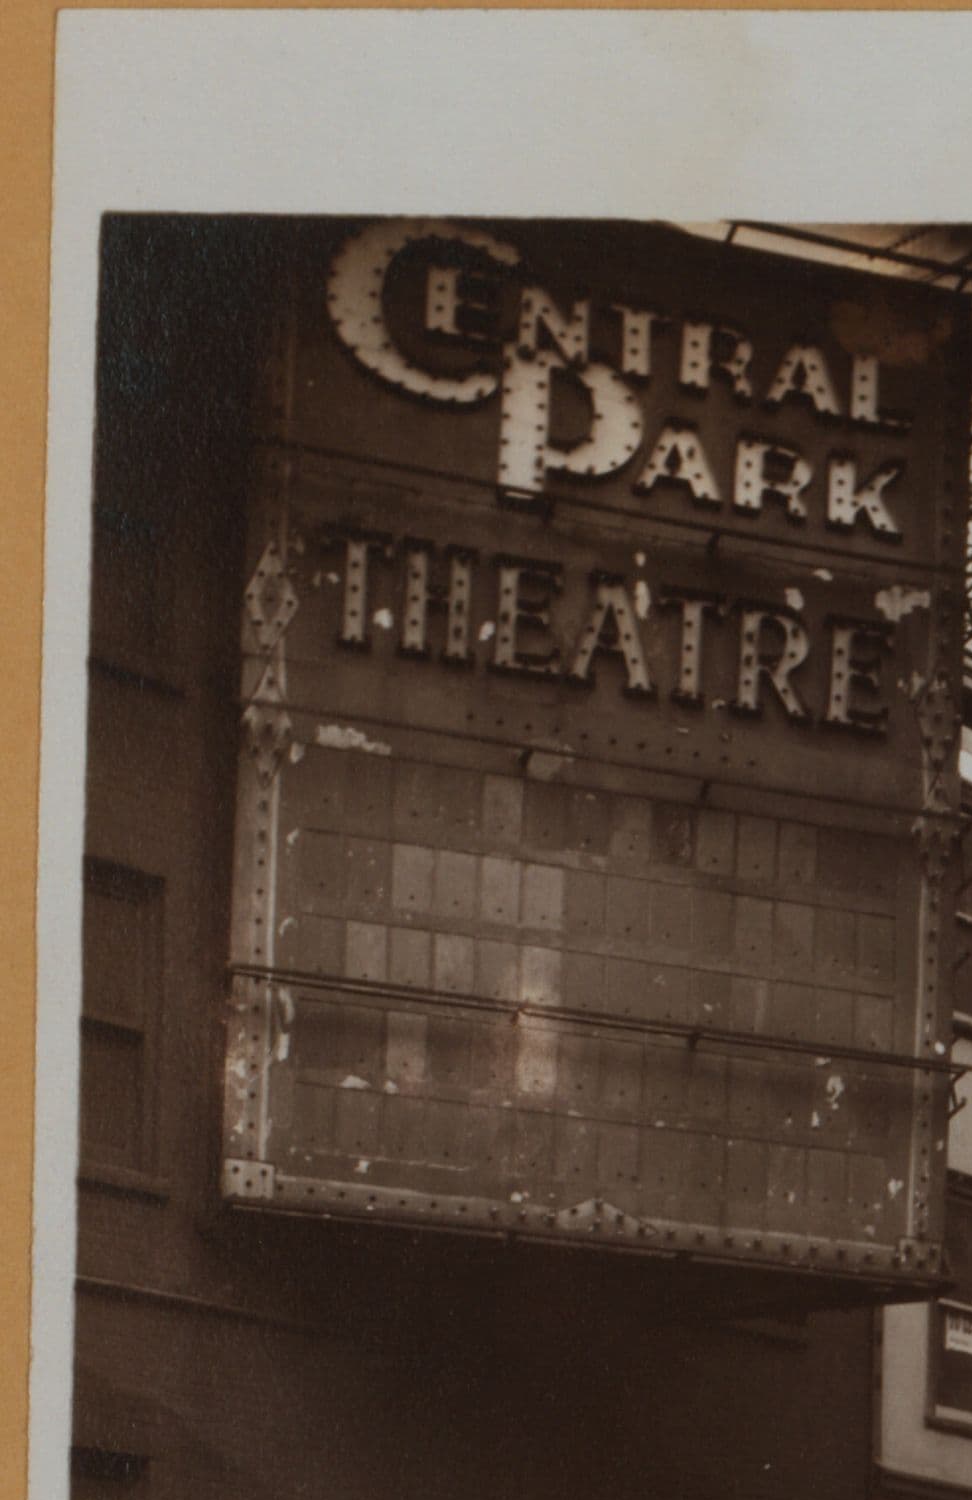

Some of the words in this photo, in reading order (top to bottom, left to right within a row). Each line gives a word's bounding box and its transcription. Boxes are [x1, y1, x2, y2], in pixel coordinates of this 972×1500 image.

[326, 219, 912, 433] CENTRAL
[498, 345, 904, 542] PARK
[322, 521, 895, 738] THEATRE
